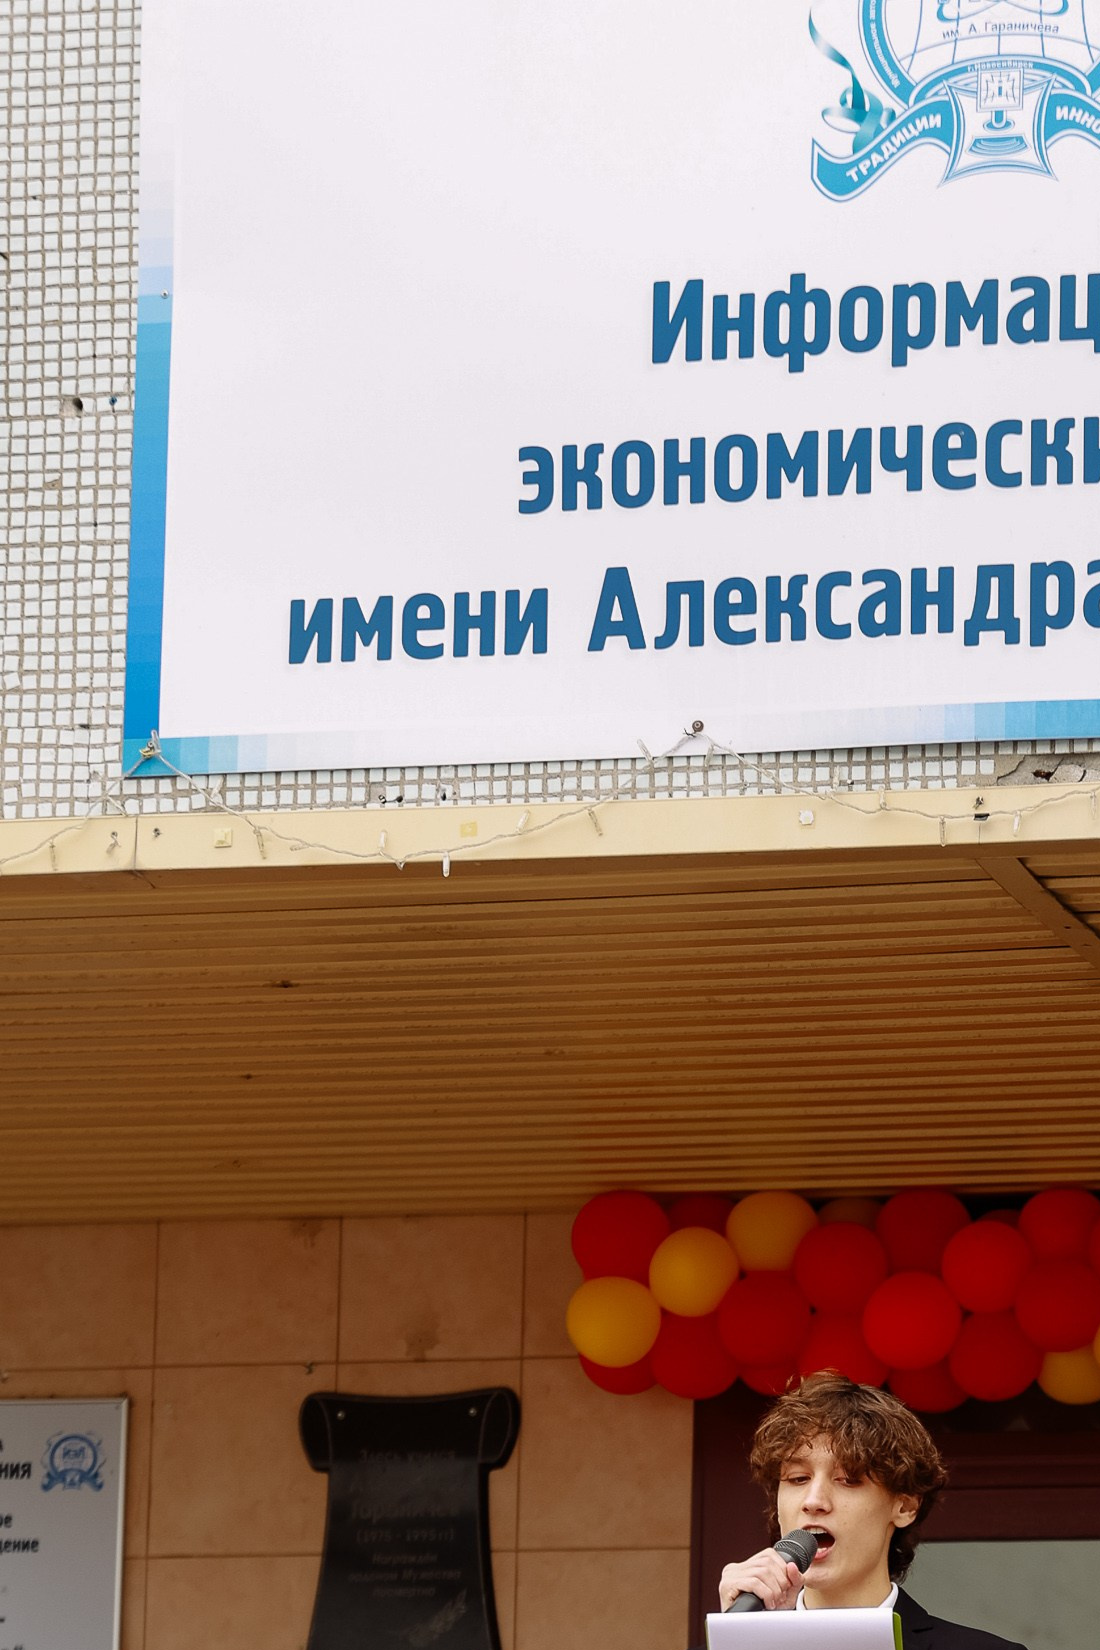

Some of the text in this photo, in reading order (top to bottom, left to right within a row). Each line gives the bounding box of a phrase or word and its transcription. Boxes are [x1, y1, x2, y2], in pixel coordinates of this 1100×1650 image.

[984, 21, 1060, 34] Гараничева
[846, 113, 942, 183] ТРАДИЦИИ
[288, 588, 548, 664] имени
